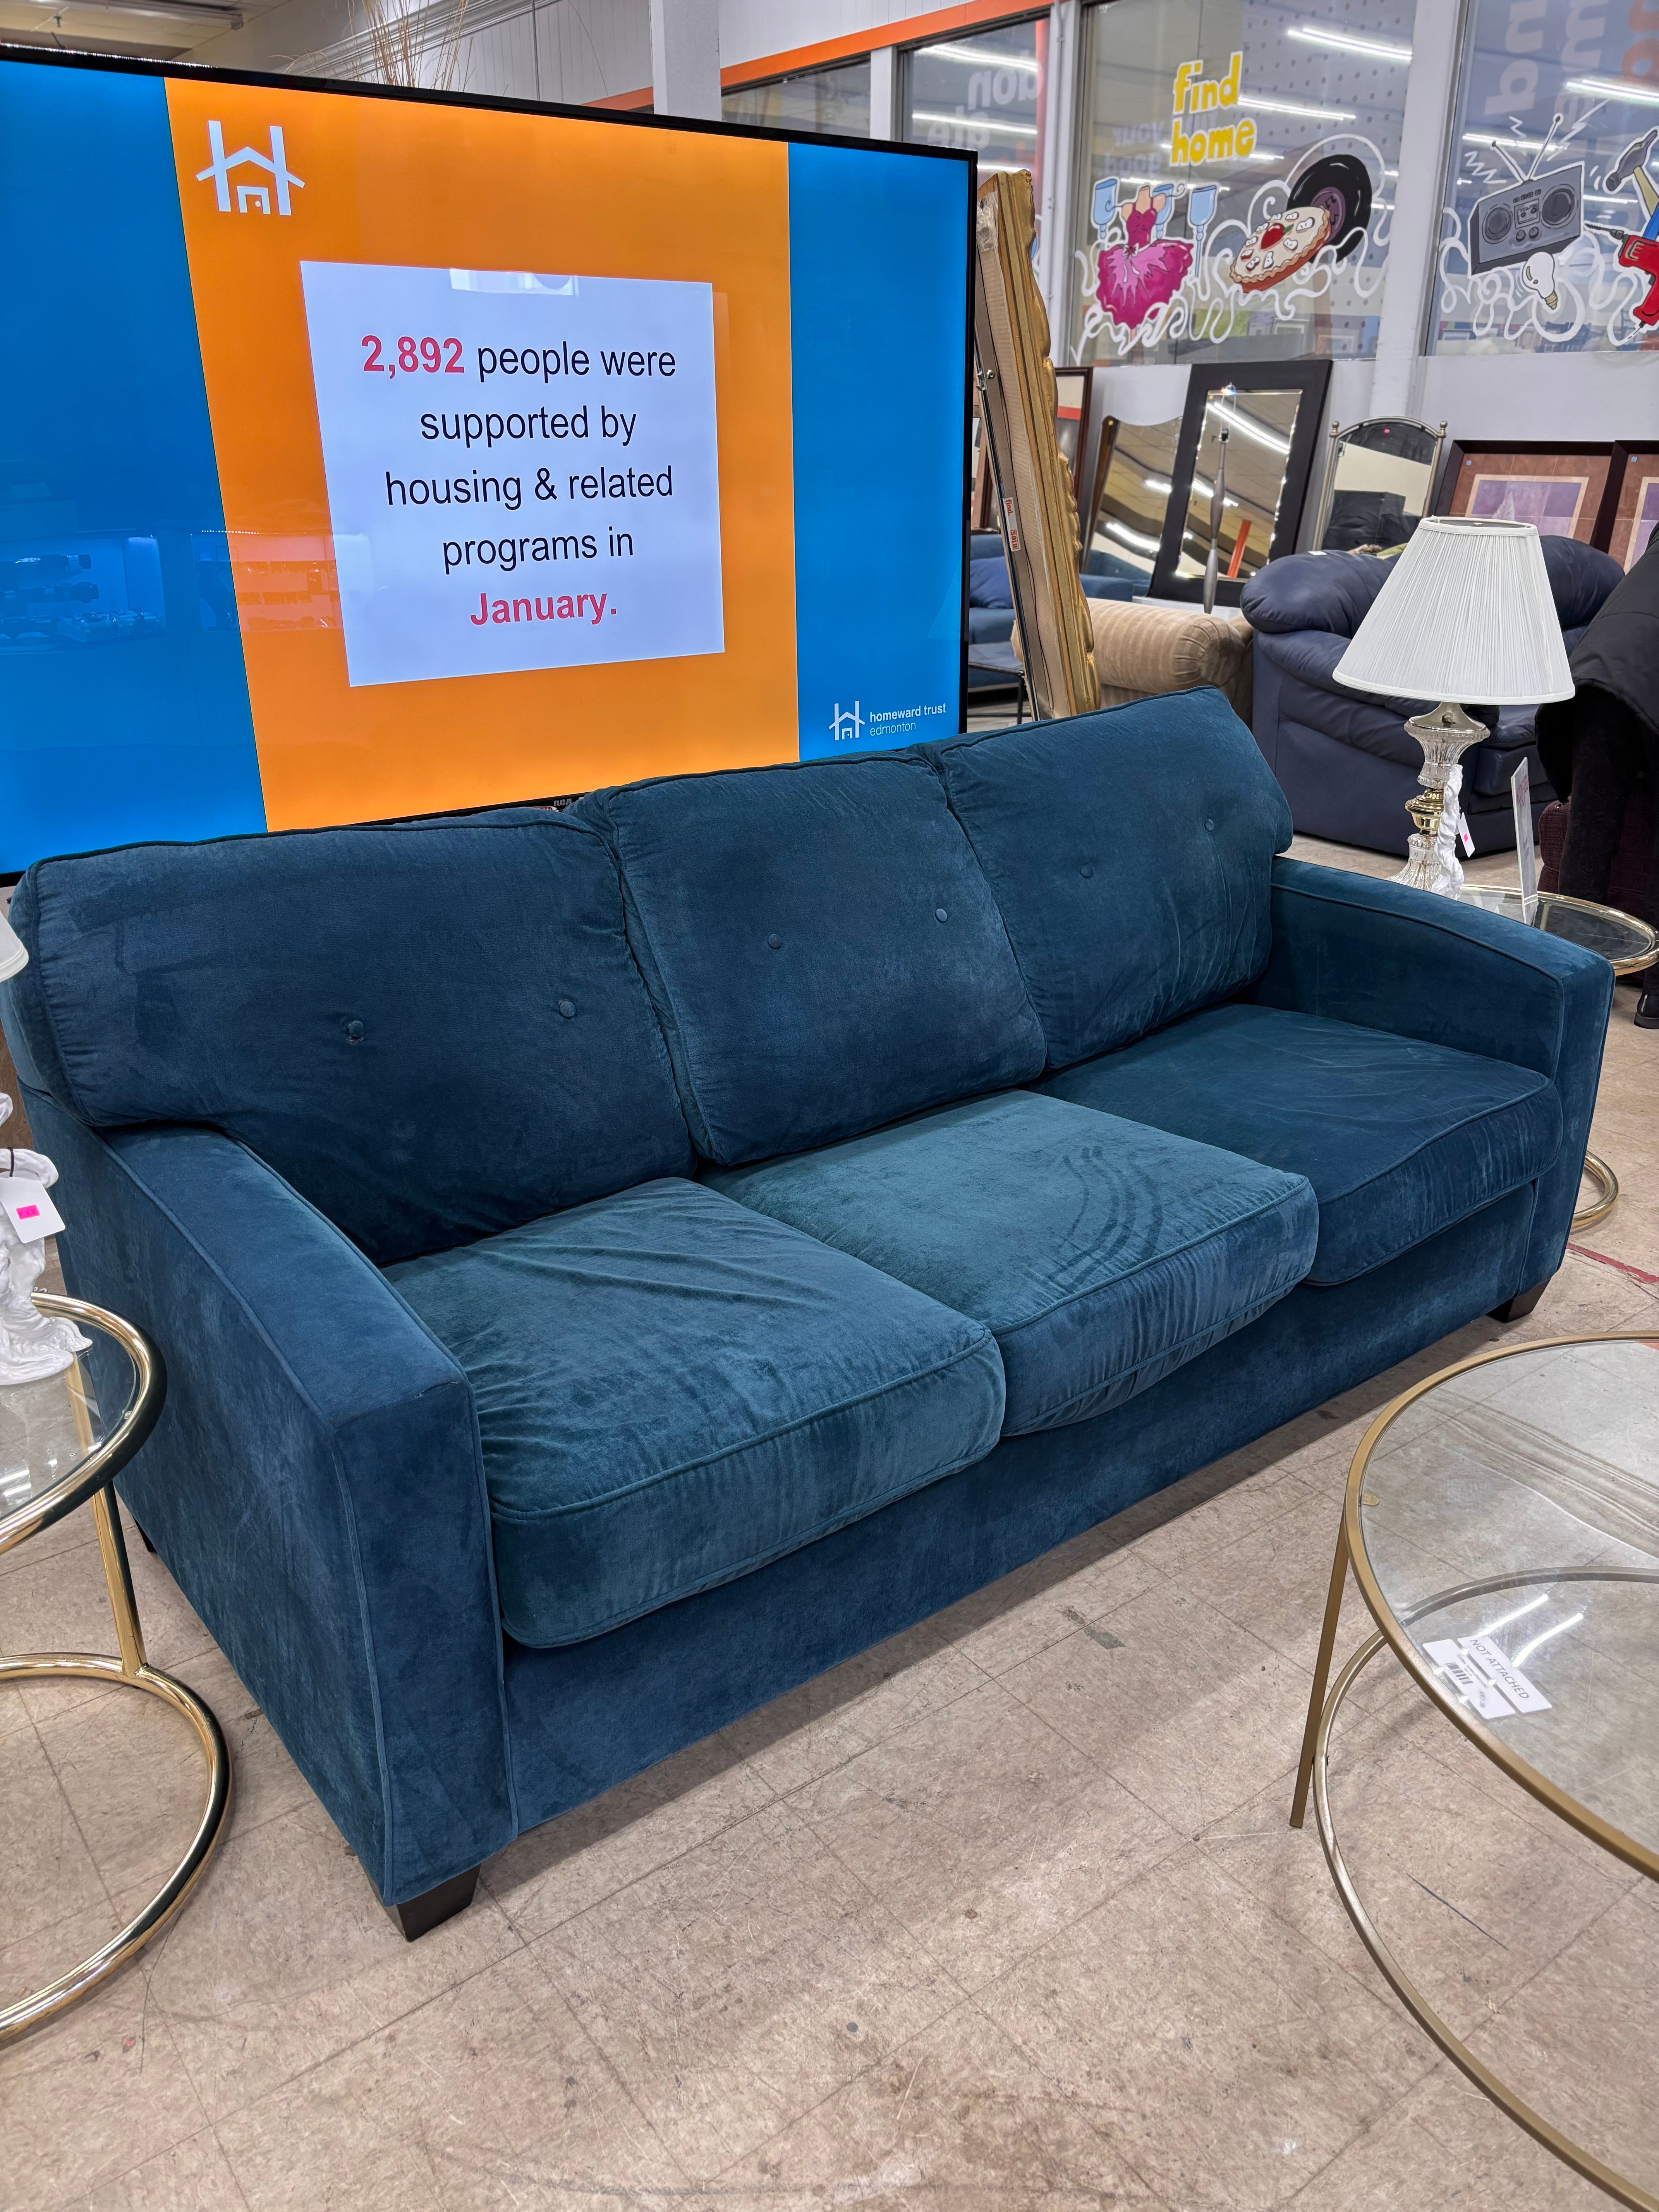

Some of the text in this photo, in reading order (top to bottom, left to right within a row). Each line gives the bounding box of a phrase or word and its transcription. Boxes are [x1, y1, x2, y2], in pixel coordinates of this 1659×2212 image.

[1174, 53, 1241, 113] find
[1170, 118, 1255, 165] home
[361, 335, 676, 384] 2,892 people were
[420, 405, 637, 448] supported by
[385, 465, 673, 511] housing & related
[443, 526, 634, 575] programs in
[470, 592, 617, 625] January.
[870, 703, 946, 723] homeward trust
[870, 722, 916, 736] edmonton
[553, 798, 572, 807] RCA
[1470, 1639, 1491, 1656] NOT
[1486, 1658, 1529, 1699] ATTACHED
